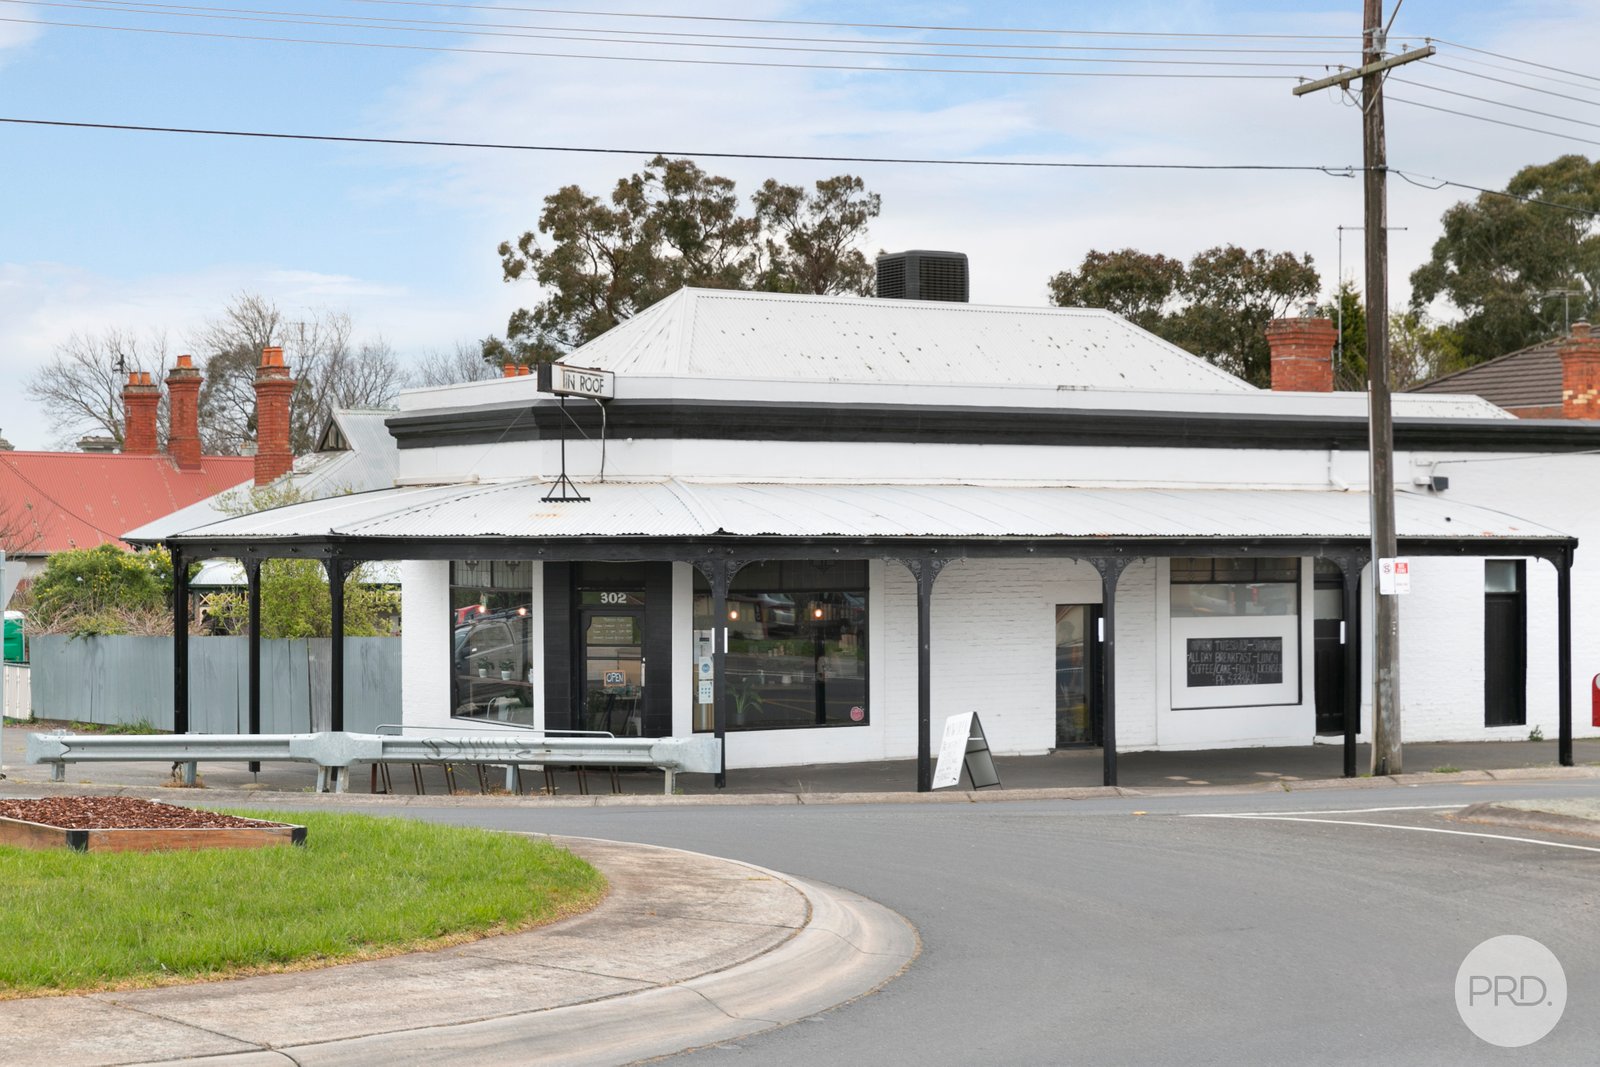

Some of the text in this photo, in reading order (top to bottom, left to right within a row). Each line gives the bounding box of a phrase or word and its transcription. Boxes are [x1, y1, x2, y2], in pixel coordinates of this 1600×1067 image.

[580, 375, 604, 394] ROOF
[600, 592, 627, 604] 302
[606, 672, 624, 682] OPEN
